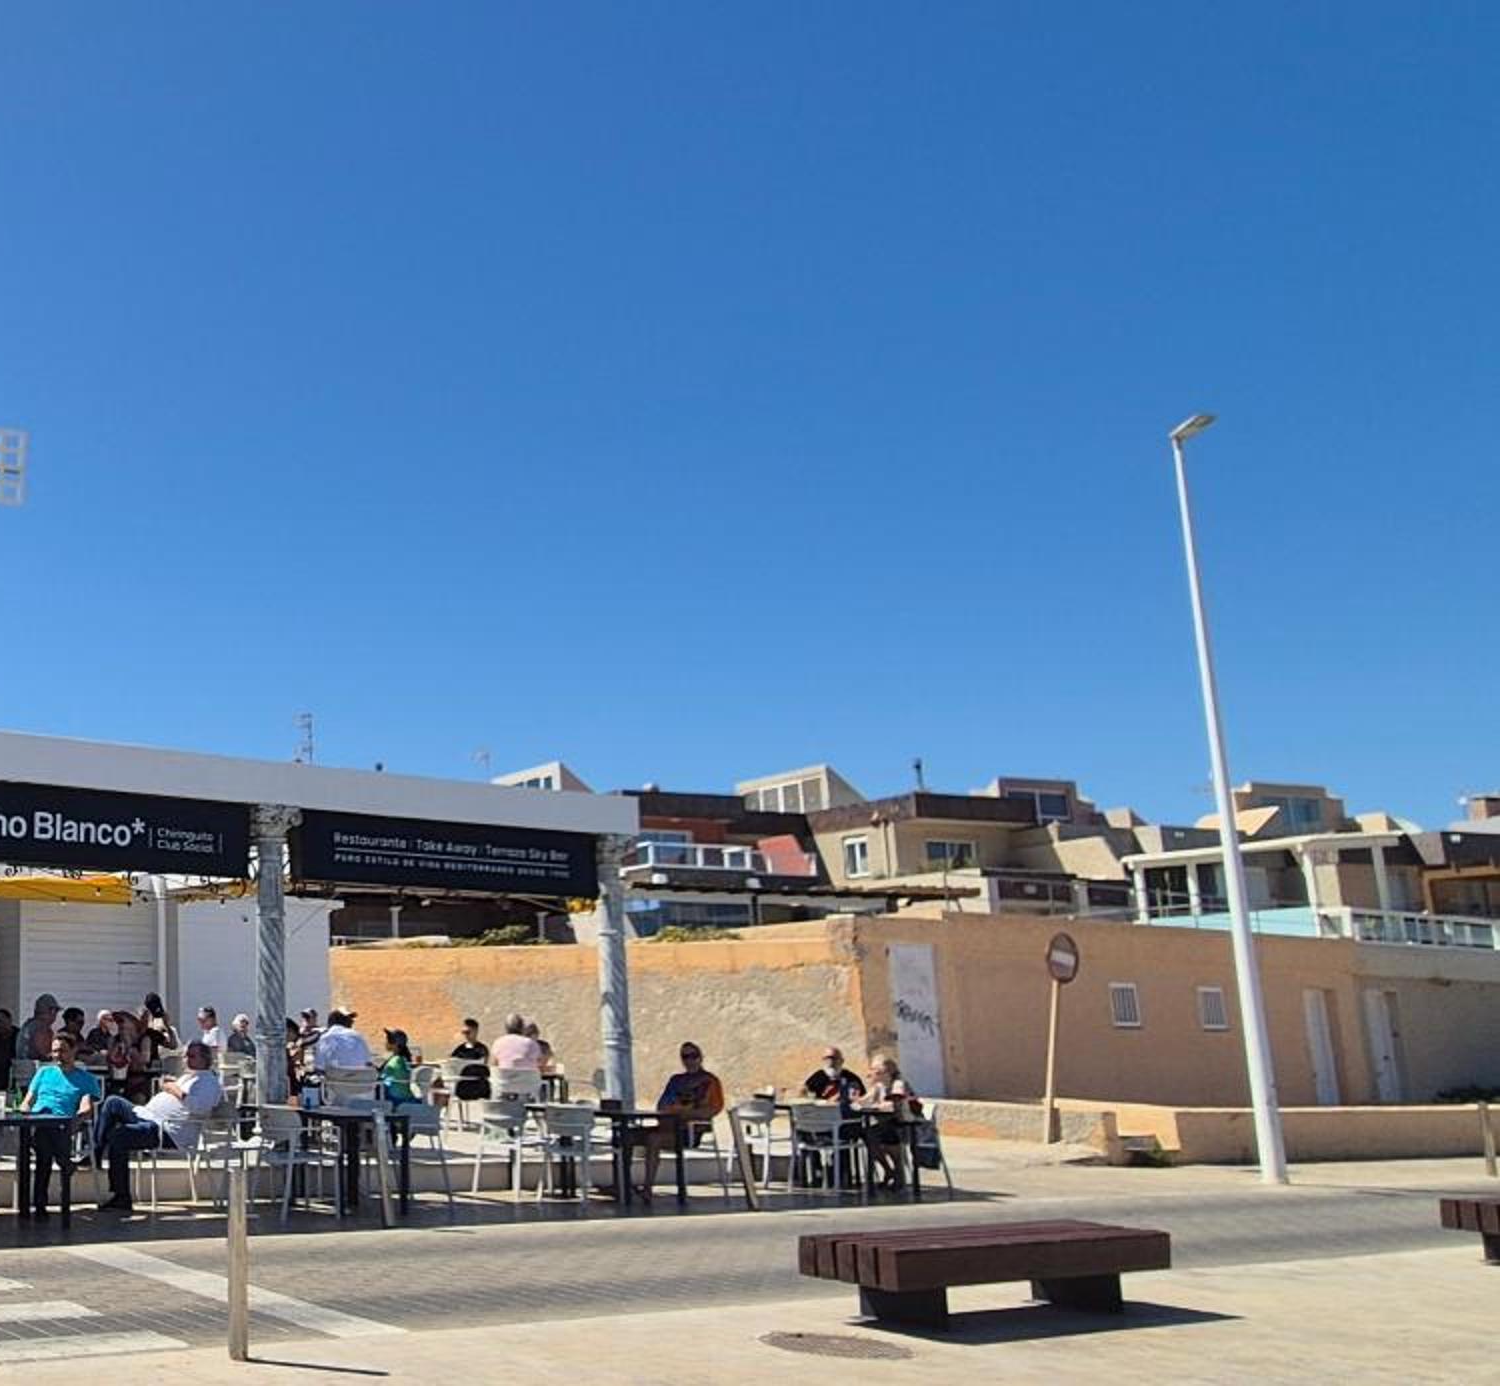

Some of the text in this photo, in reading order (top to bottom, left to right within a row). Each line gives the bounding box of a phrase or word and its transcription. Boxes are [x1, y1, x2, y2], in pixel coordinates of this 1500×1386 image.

[157, 840, 181, 851] Club
[333, 831, 407, 848] Restaurante
[417, 839, 443, 852] Take
[446, 842, 477, 857] Away
[529, 848, 547, 861] Sky
